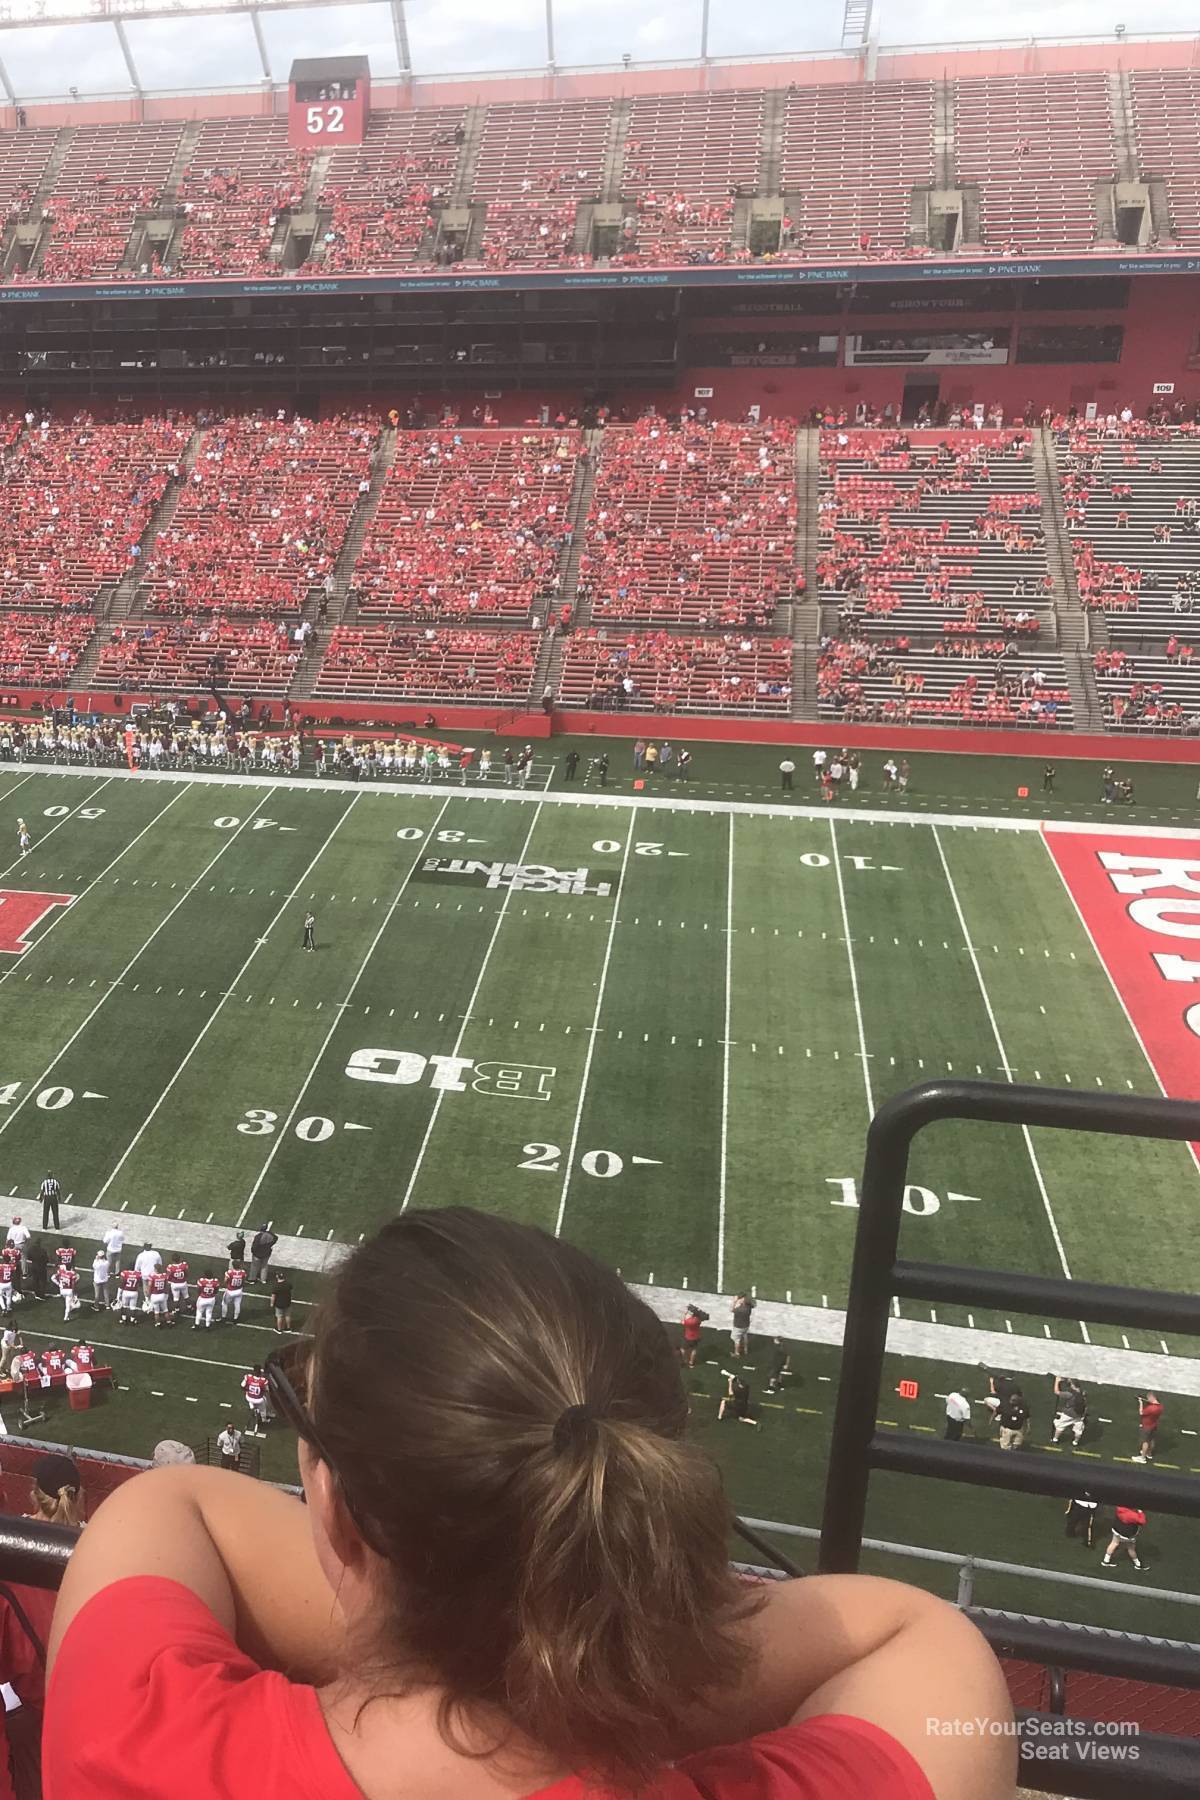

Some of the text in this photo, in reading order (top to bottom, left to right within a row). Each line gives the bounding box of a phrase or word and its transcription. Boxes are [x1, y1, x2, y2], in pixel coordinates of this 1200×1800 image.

[306, 105, 344, 134] 52
[43, 805, 106, 819] 50
[214, 816, 278, 830] 40
[397, 827, 465, 843] 30
[592, 840, 664, 855] 20
[800, 853, 876, 869] 10
[487, 875, 611, 896] HIGH
[236, 1109, 335, 1142] 30
[516, 1142, 624, 1178] 20
[825, 1177, 941, 1216] 10
[126, 1279, 137, 1288] 57
[903, 1382, 915, 1396] 10
